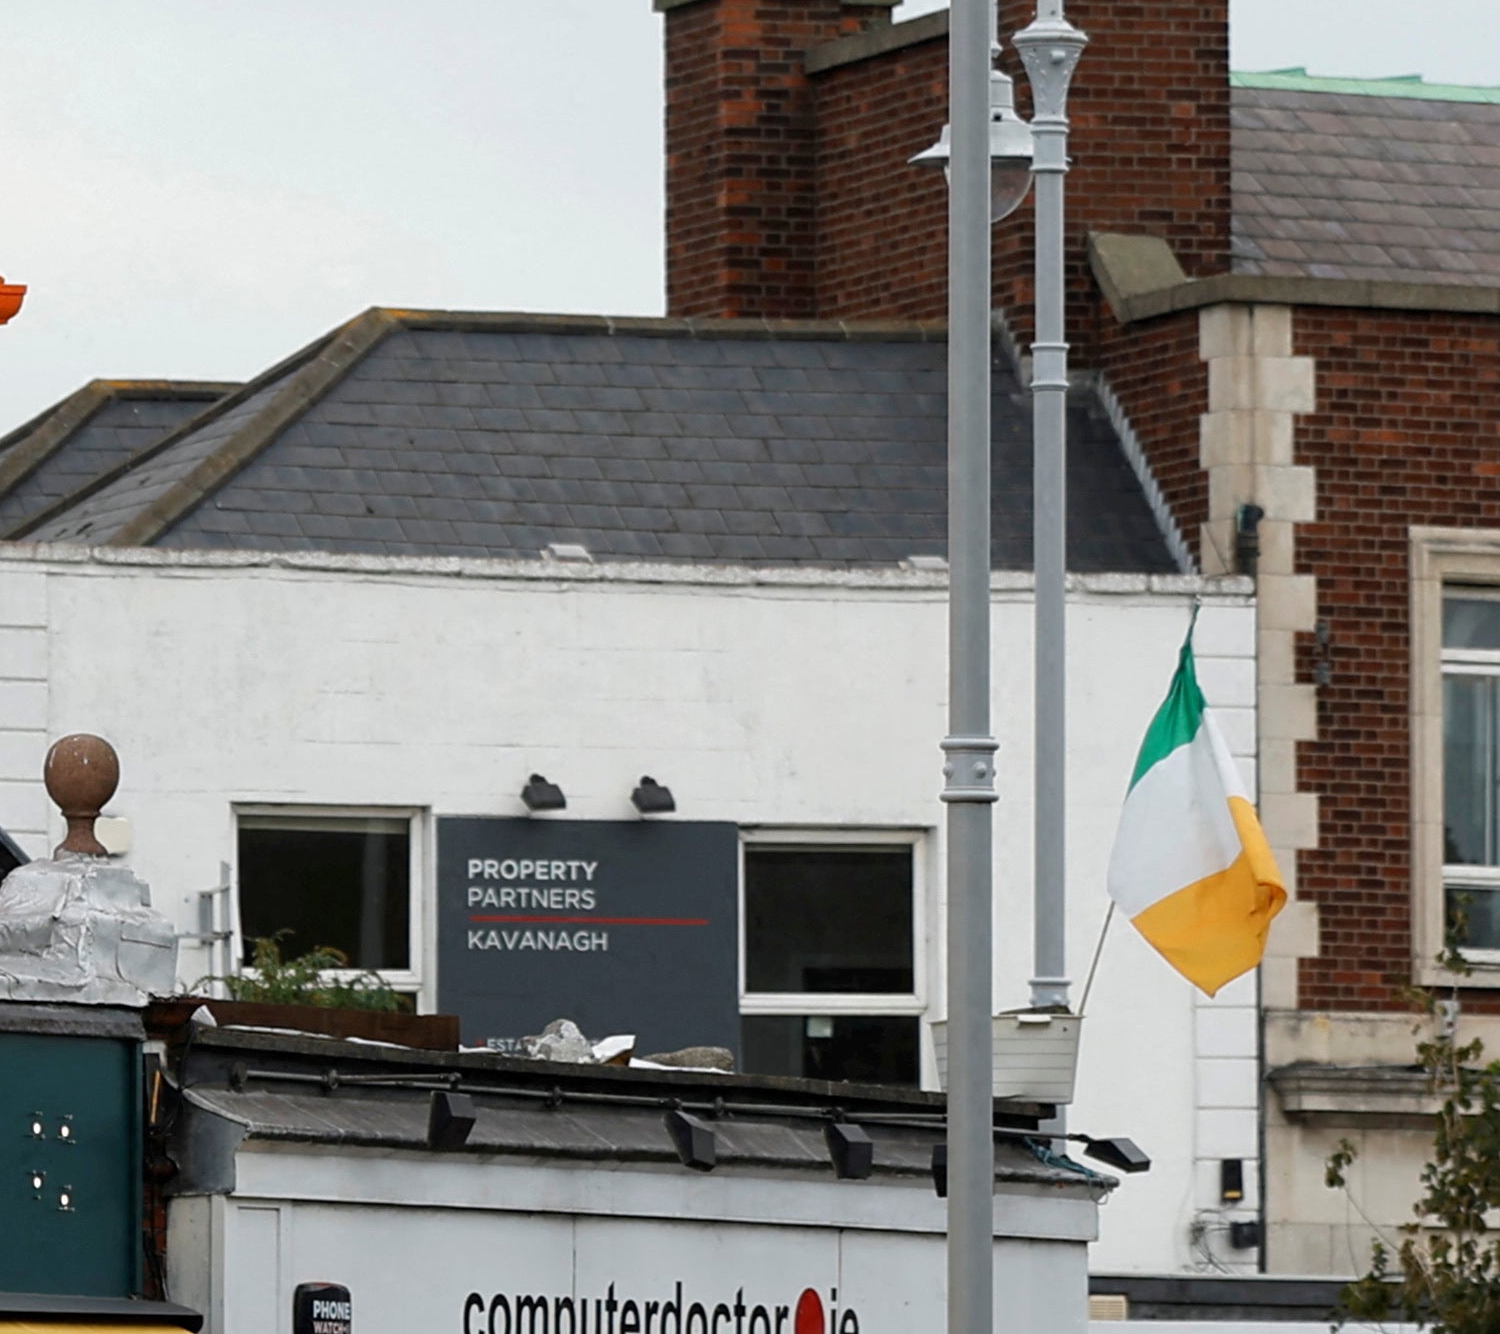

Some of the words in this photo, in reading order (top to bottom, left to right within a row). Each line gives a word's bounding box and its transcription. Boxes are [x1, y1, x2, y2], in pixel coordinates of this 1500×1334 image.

[467, 859, 598, 881] PROPERTY
[467, 886, 597, 910] PARTNERS
[467, 929, 609, 952] KAVANAGH
[312, 1299, 351, 1320] PHONE
